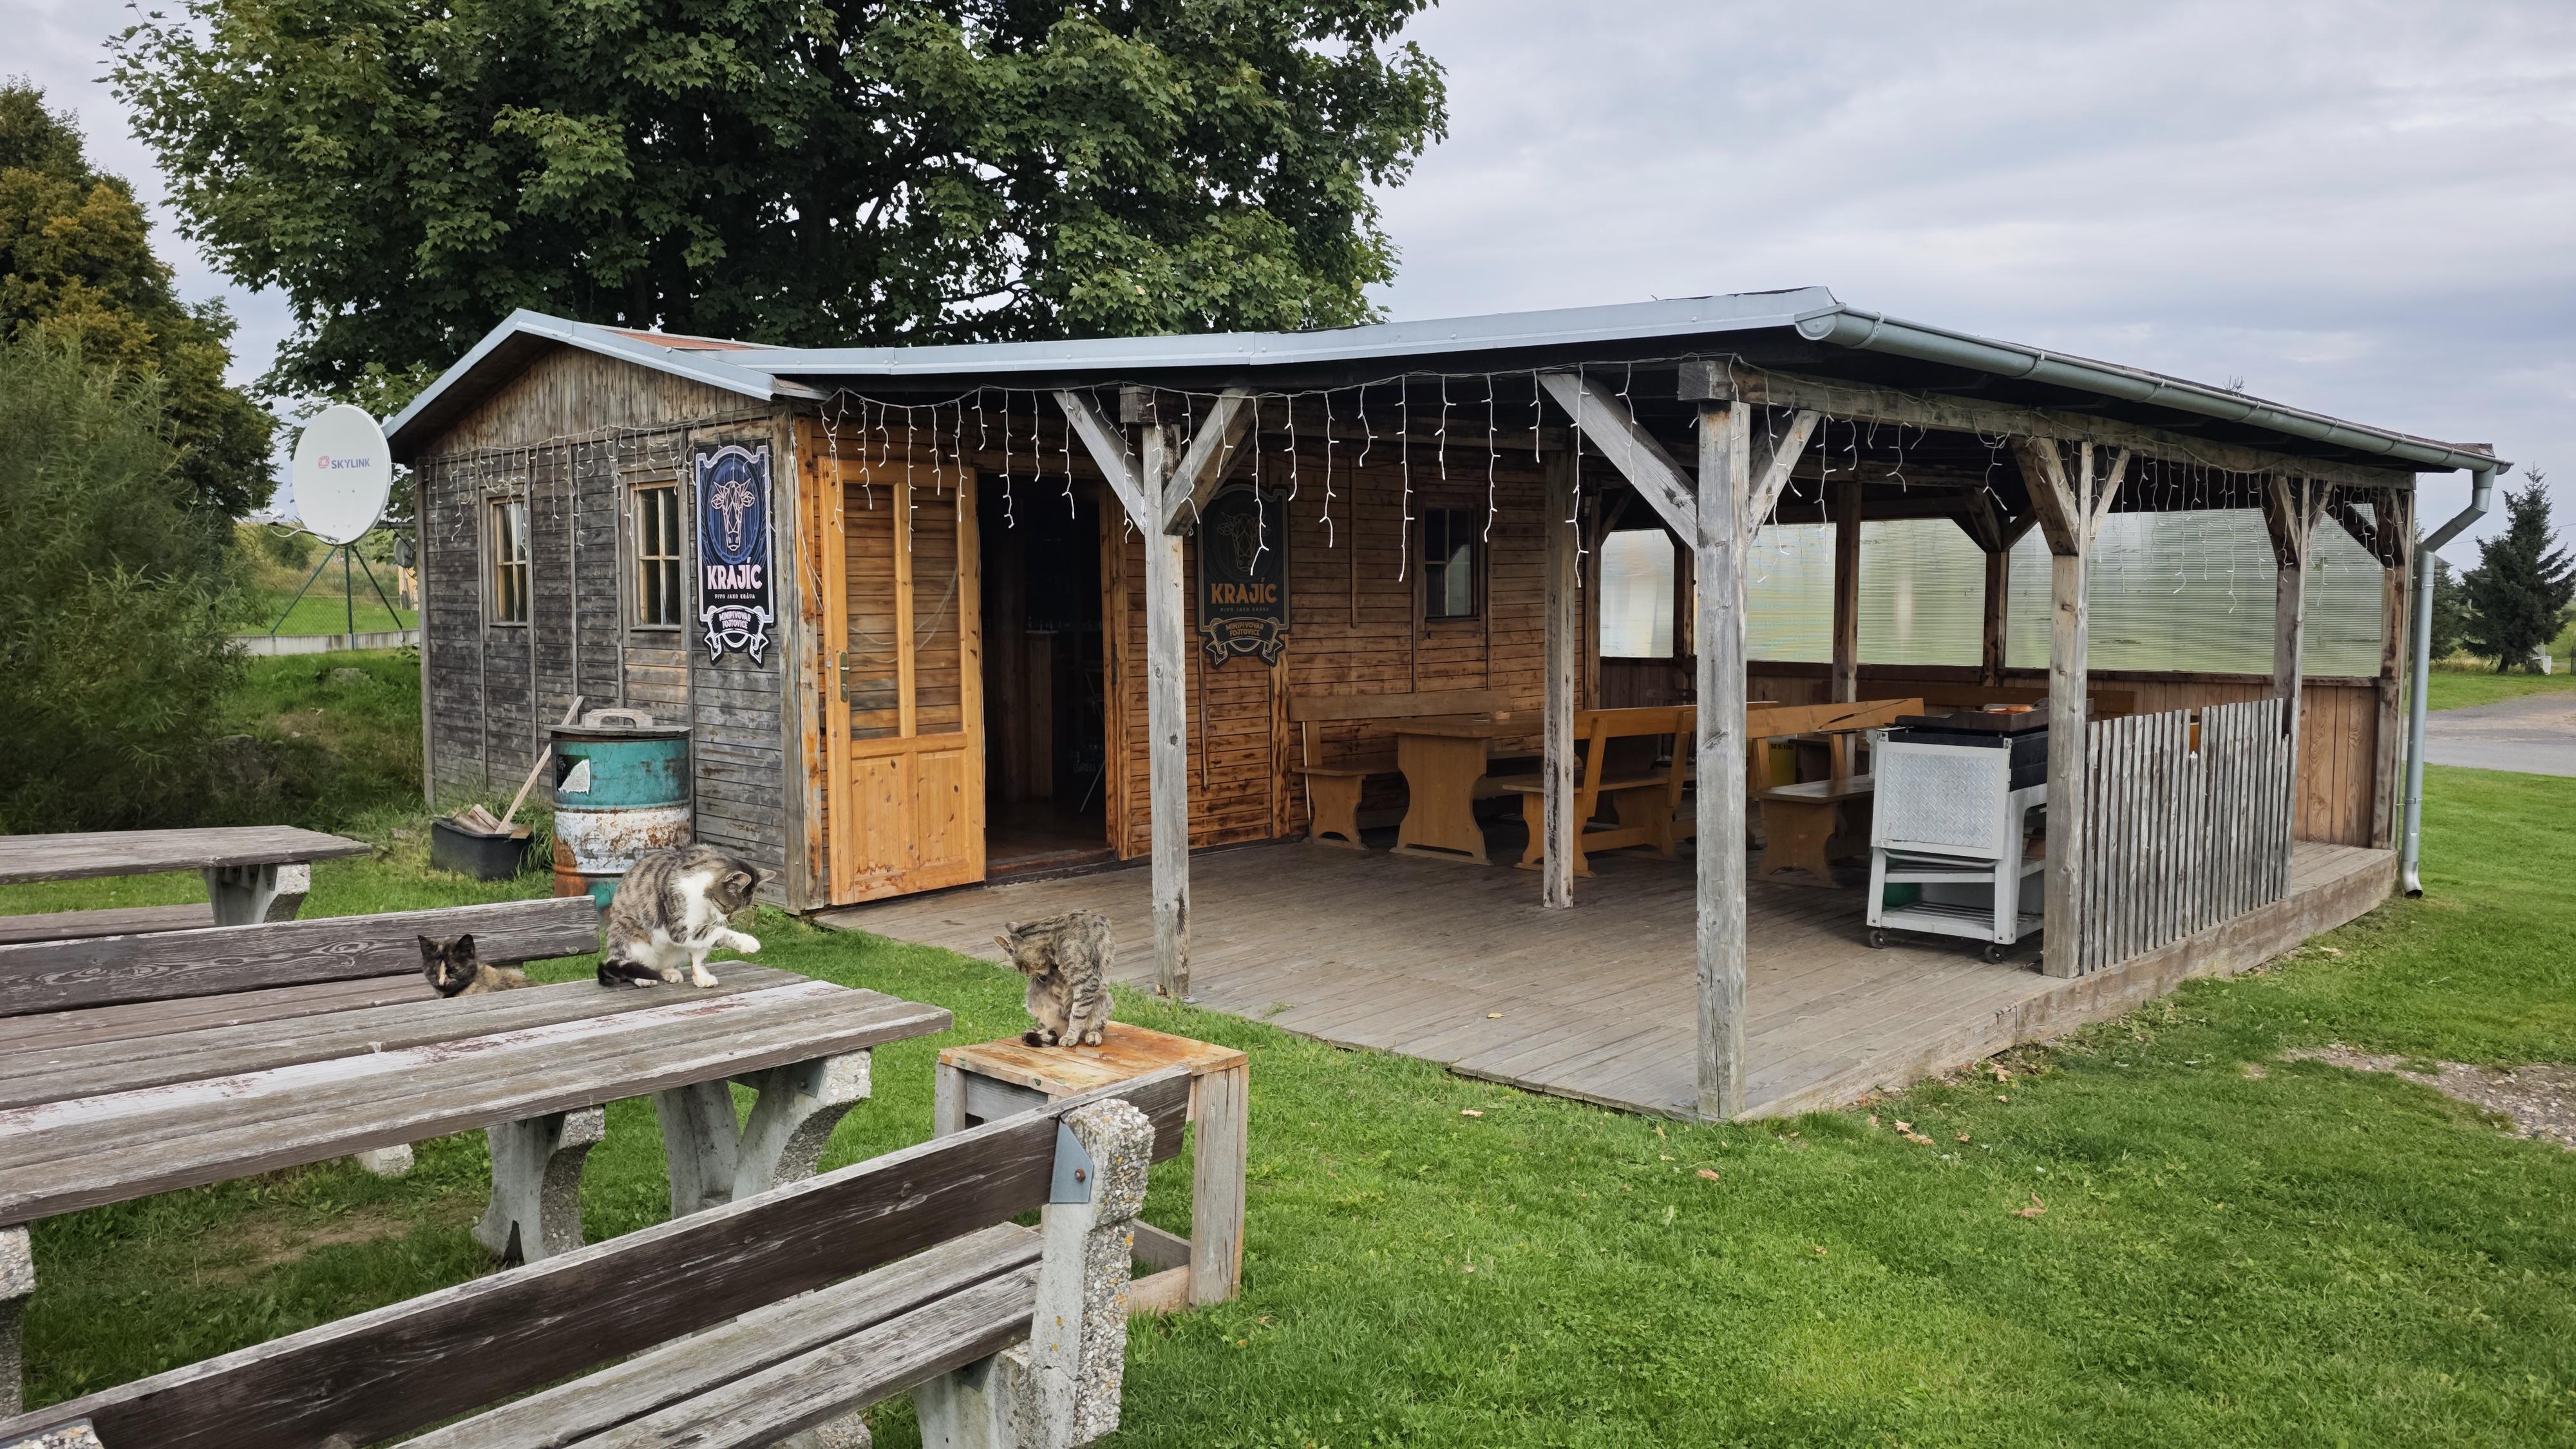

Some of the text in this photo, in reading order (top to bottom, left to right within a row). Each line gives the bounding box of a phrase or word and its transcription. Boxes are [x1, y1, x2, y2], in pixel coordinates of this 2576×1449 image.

[331, 458, 370, 469] SKYLINK
[707, 556, 762, 590] KRAJÍC
[1211, 577, 1277, 603] KRAJÍC
[719, 611, 752, 622] MINIPIVOVAR
[722, 619, 748, 629] FOJTOVICE
[1226, 621, 1264, 631] MINIPIVOVAR
